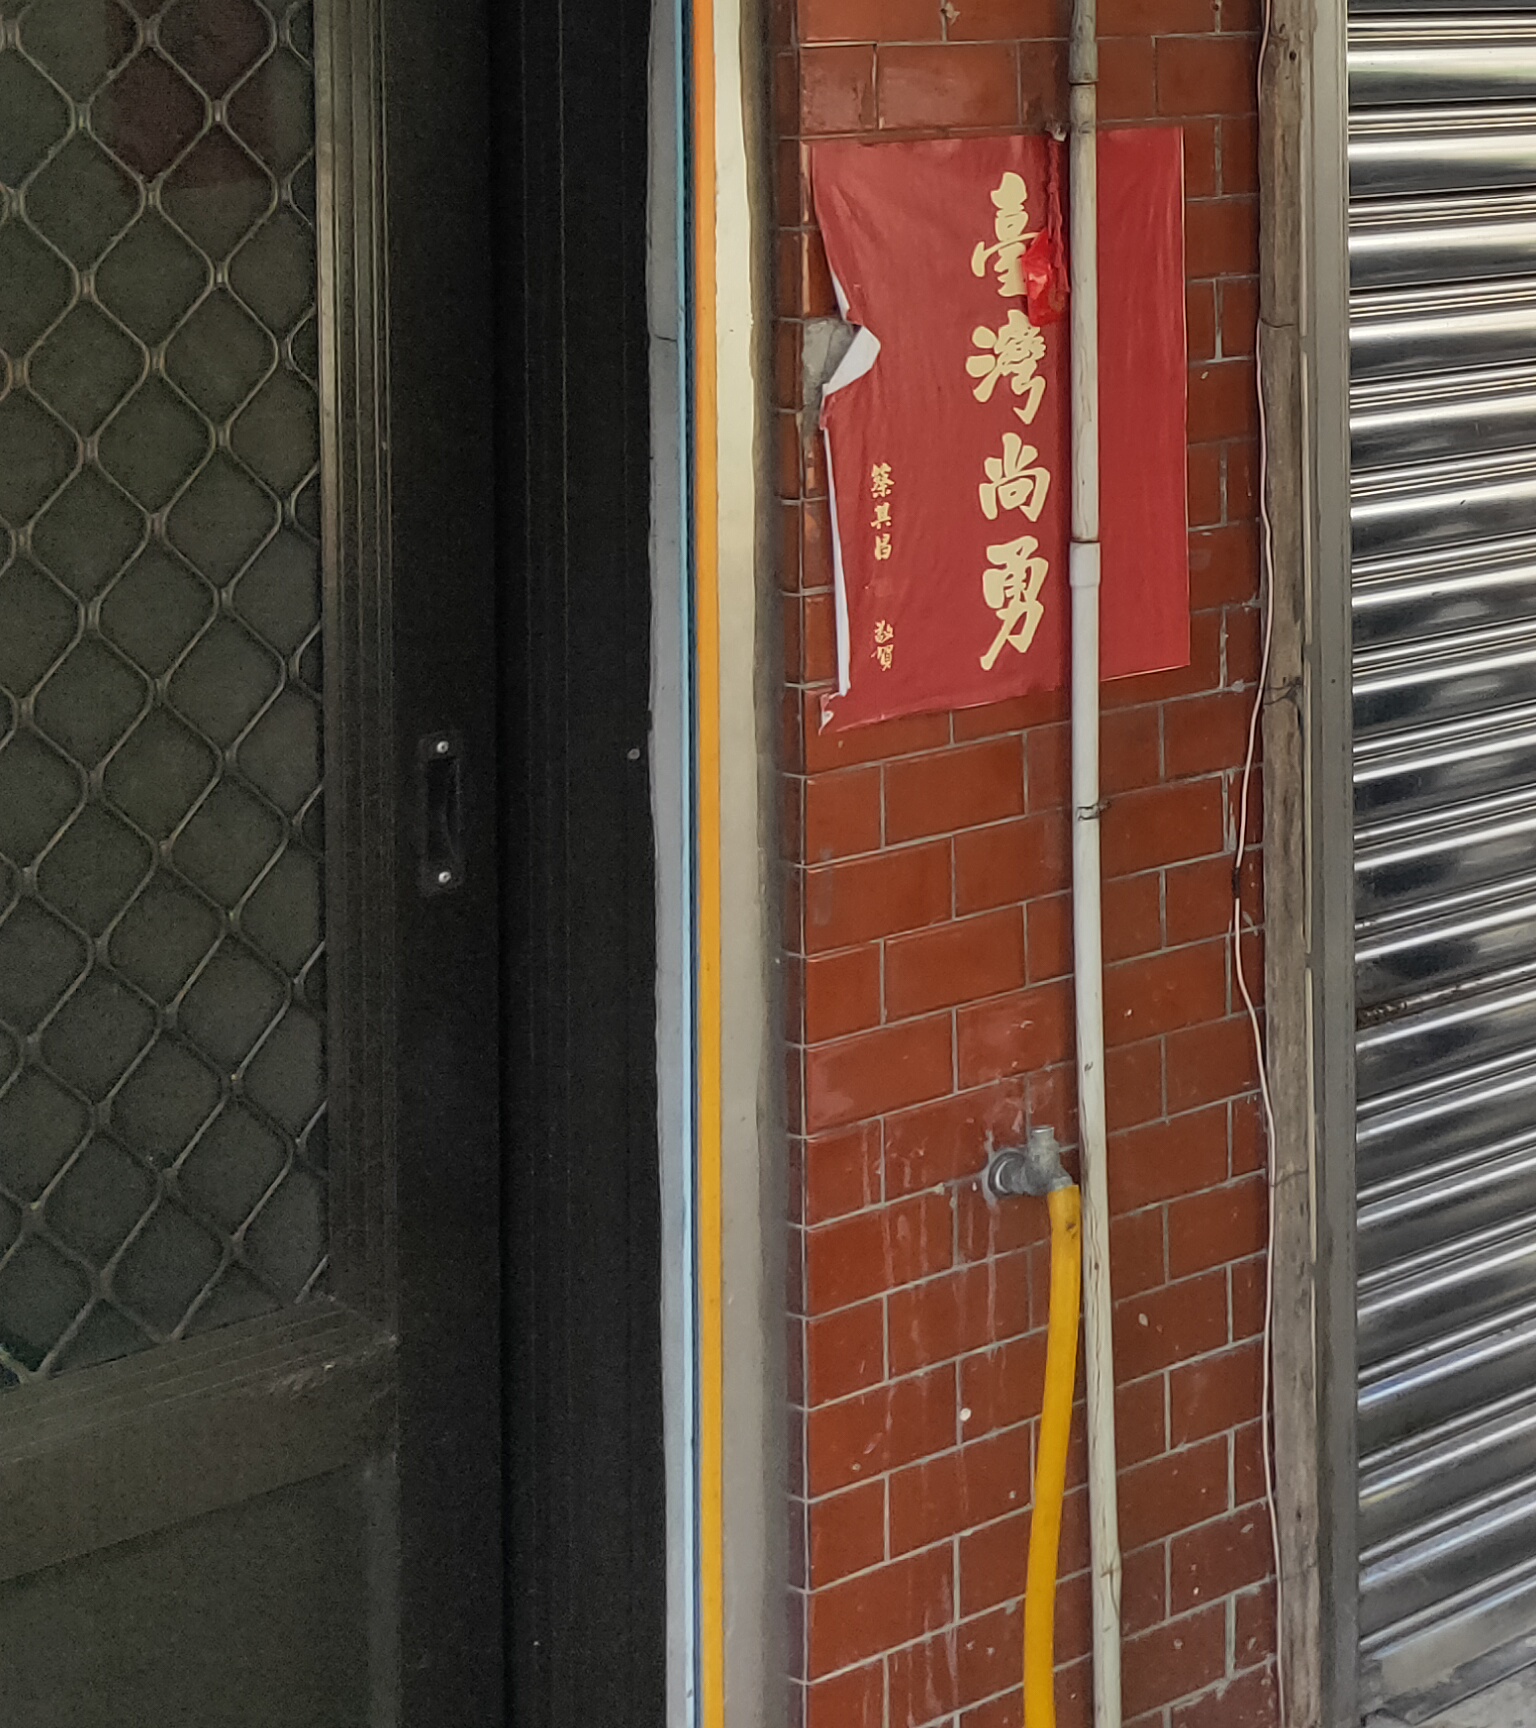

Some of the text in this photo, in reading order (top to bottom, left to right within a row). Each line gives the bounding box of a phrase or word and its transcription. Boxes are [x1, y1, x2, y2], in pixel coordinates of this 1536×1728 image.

[870, 462, 895, 561] 蔡其昌
[965, 172, 1051, 671] 臺灣尚勇
